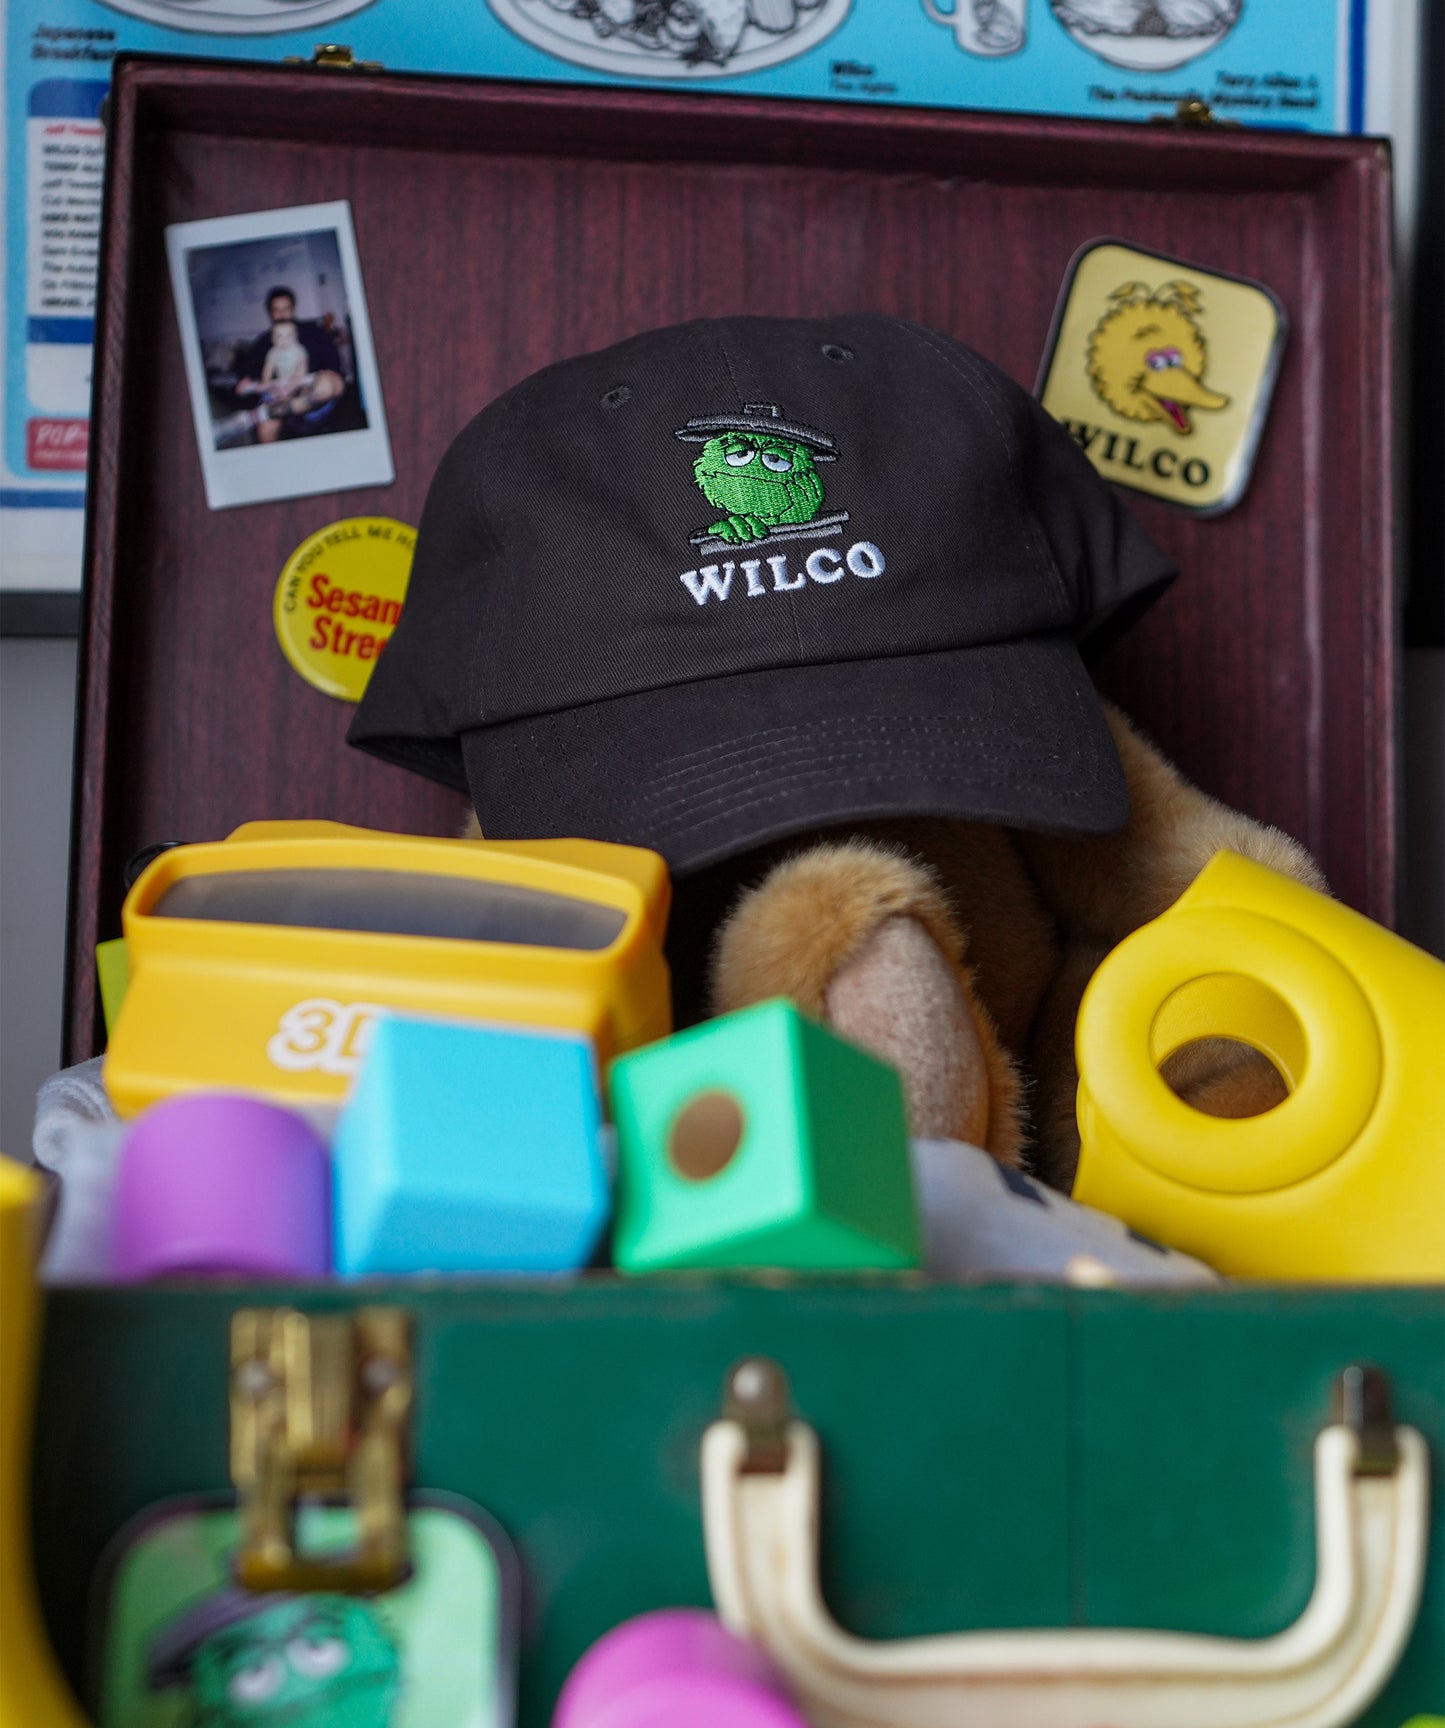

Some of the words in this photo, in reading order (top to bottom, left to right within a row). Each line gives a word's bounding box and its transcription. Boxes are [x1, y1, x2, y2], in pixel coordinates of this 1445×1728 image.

[1060, 416, 1210, 488] WILCO
[679, 541, 886, 606] WILCO
[310, 615, 387, 661] Stre
